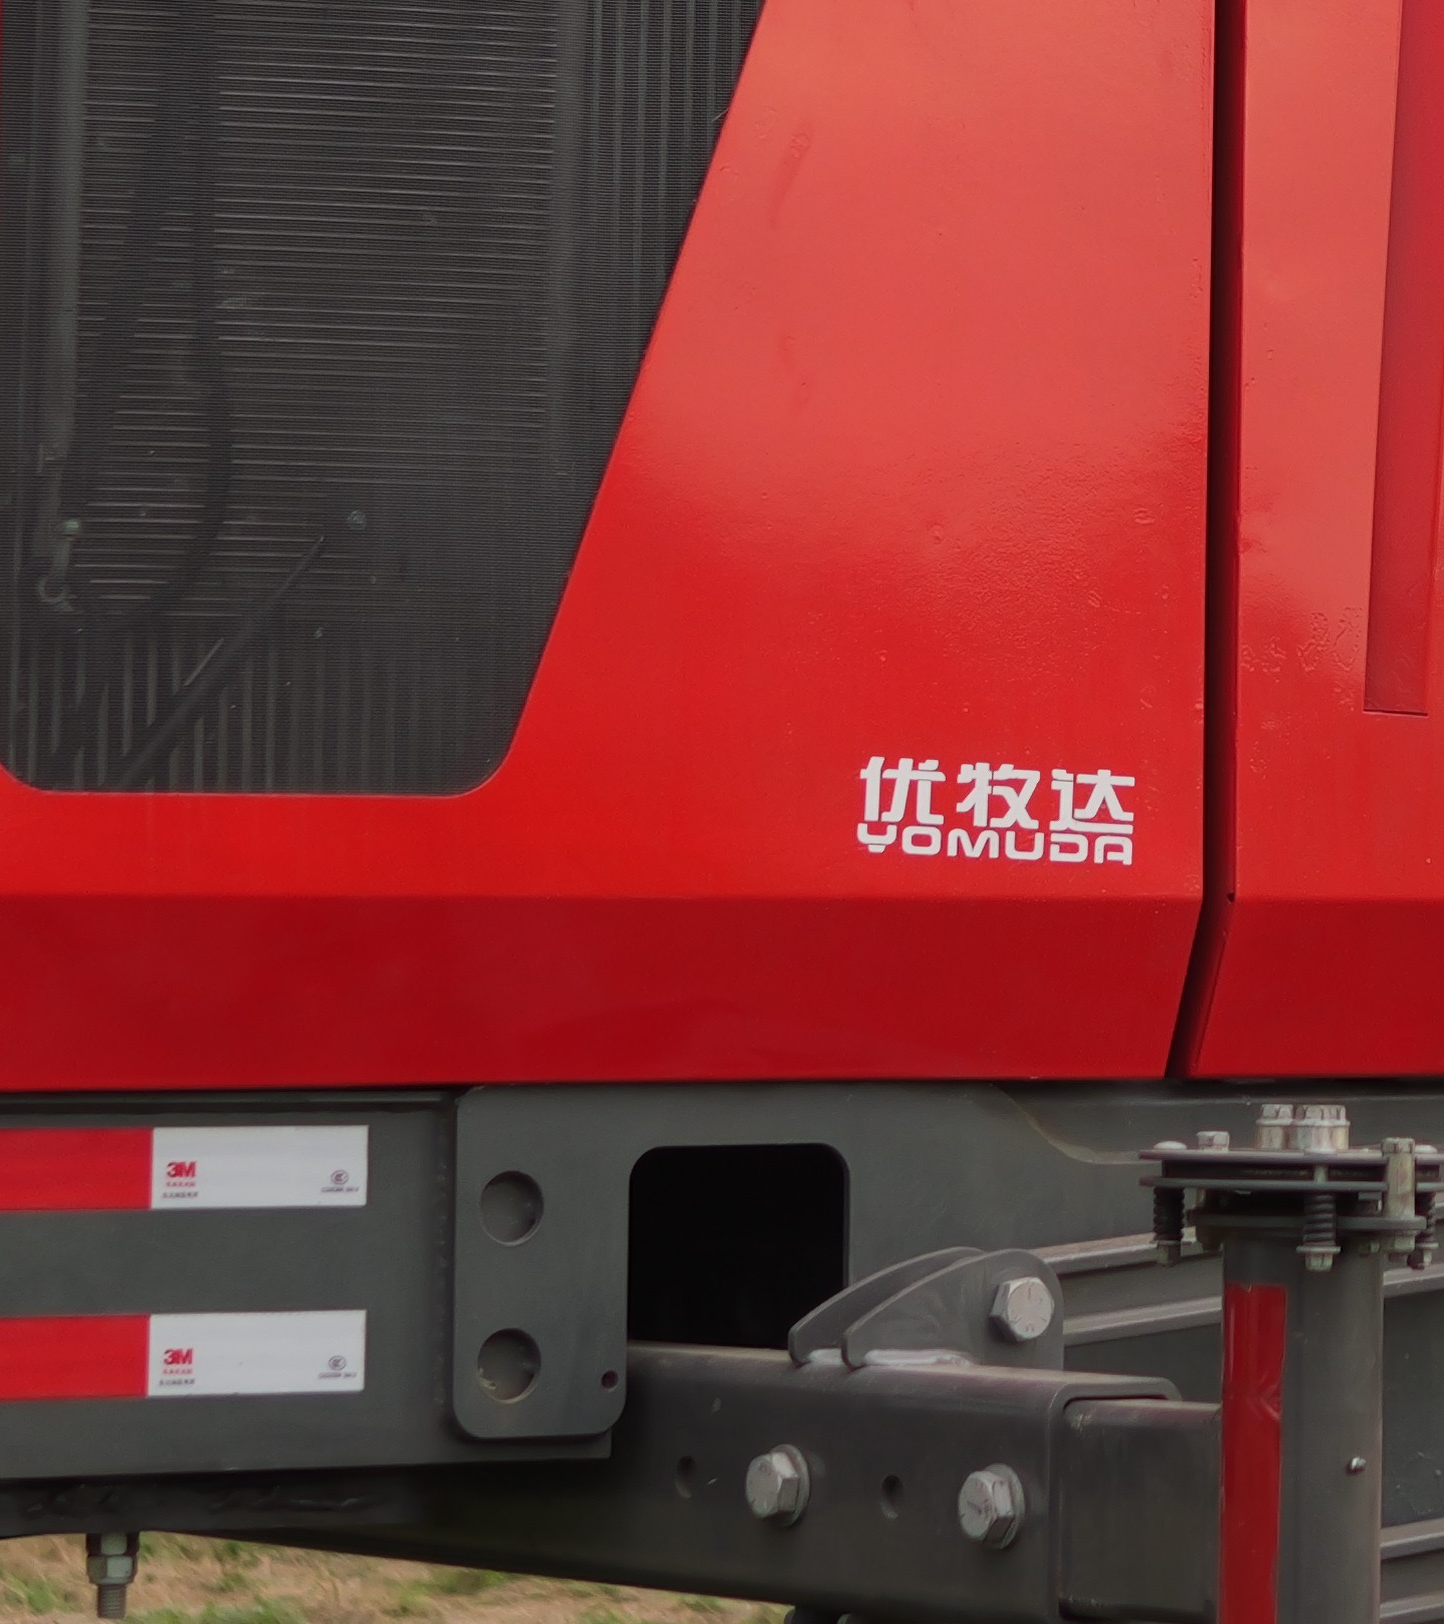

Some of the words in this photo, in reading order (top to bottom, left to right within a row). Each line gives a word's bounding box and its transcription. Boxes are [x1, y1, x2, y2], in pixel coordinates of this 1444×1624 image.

[859, 756, 1136, 835] 优牧达
[856, 822, 1133, 866] YOMUDA
[166, 1160, 197, 1179] 3M
[163, 1348, 194, 1366] 3M
